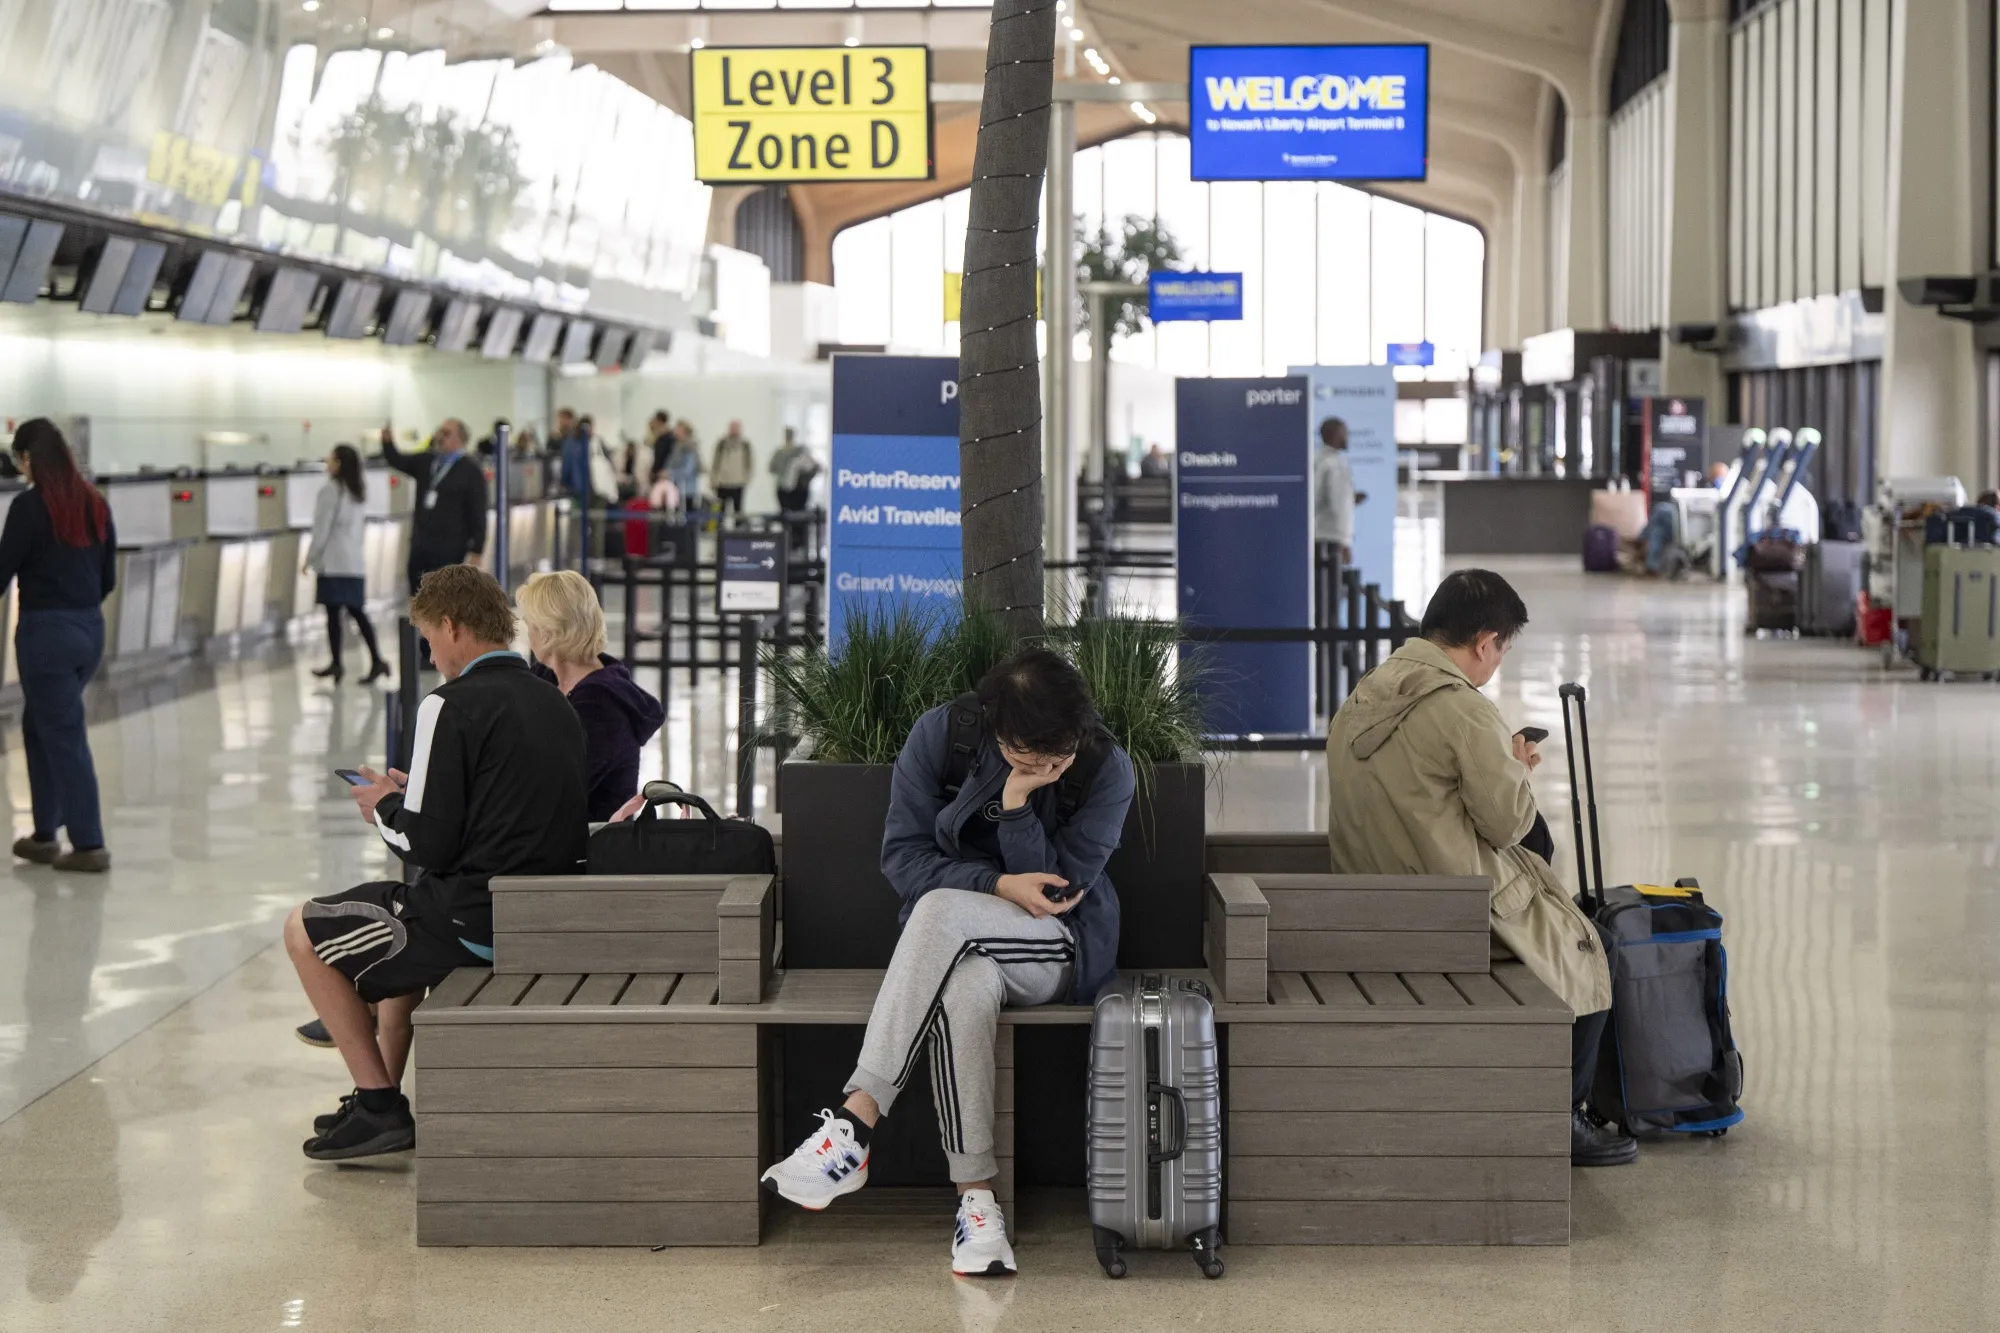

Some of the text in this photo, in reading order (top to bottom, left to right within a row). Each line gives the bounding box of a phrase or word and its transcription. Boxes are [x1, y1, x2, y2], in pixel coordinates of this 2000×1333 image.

[722, 54, 894, 106] Level 3
[1205, 74, 1406, 112] WELCOME
[1206, 117, 1220, 132] to
[1220, 116, 1263, 132] Newark
[1263, 116, 1305, 134] Liberty
[1306, 116, 1346, 134] Airport
[1346, 116, 1395, 131] Terminal
[727, 119, 900, 170] Zone D
[1245, 387, 1302, 409] porter
[838, 469, 961, 490] PorterReserv
[838, 505, 880, 525] Avid
[836, 572, 895, 592] Grand
